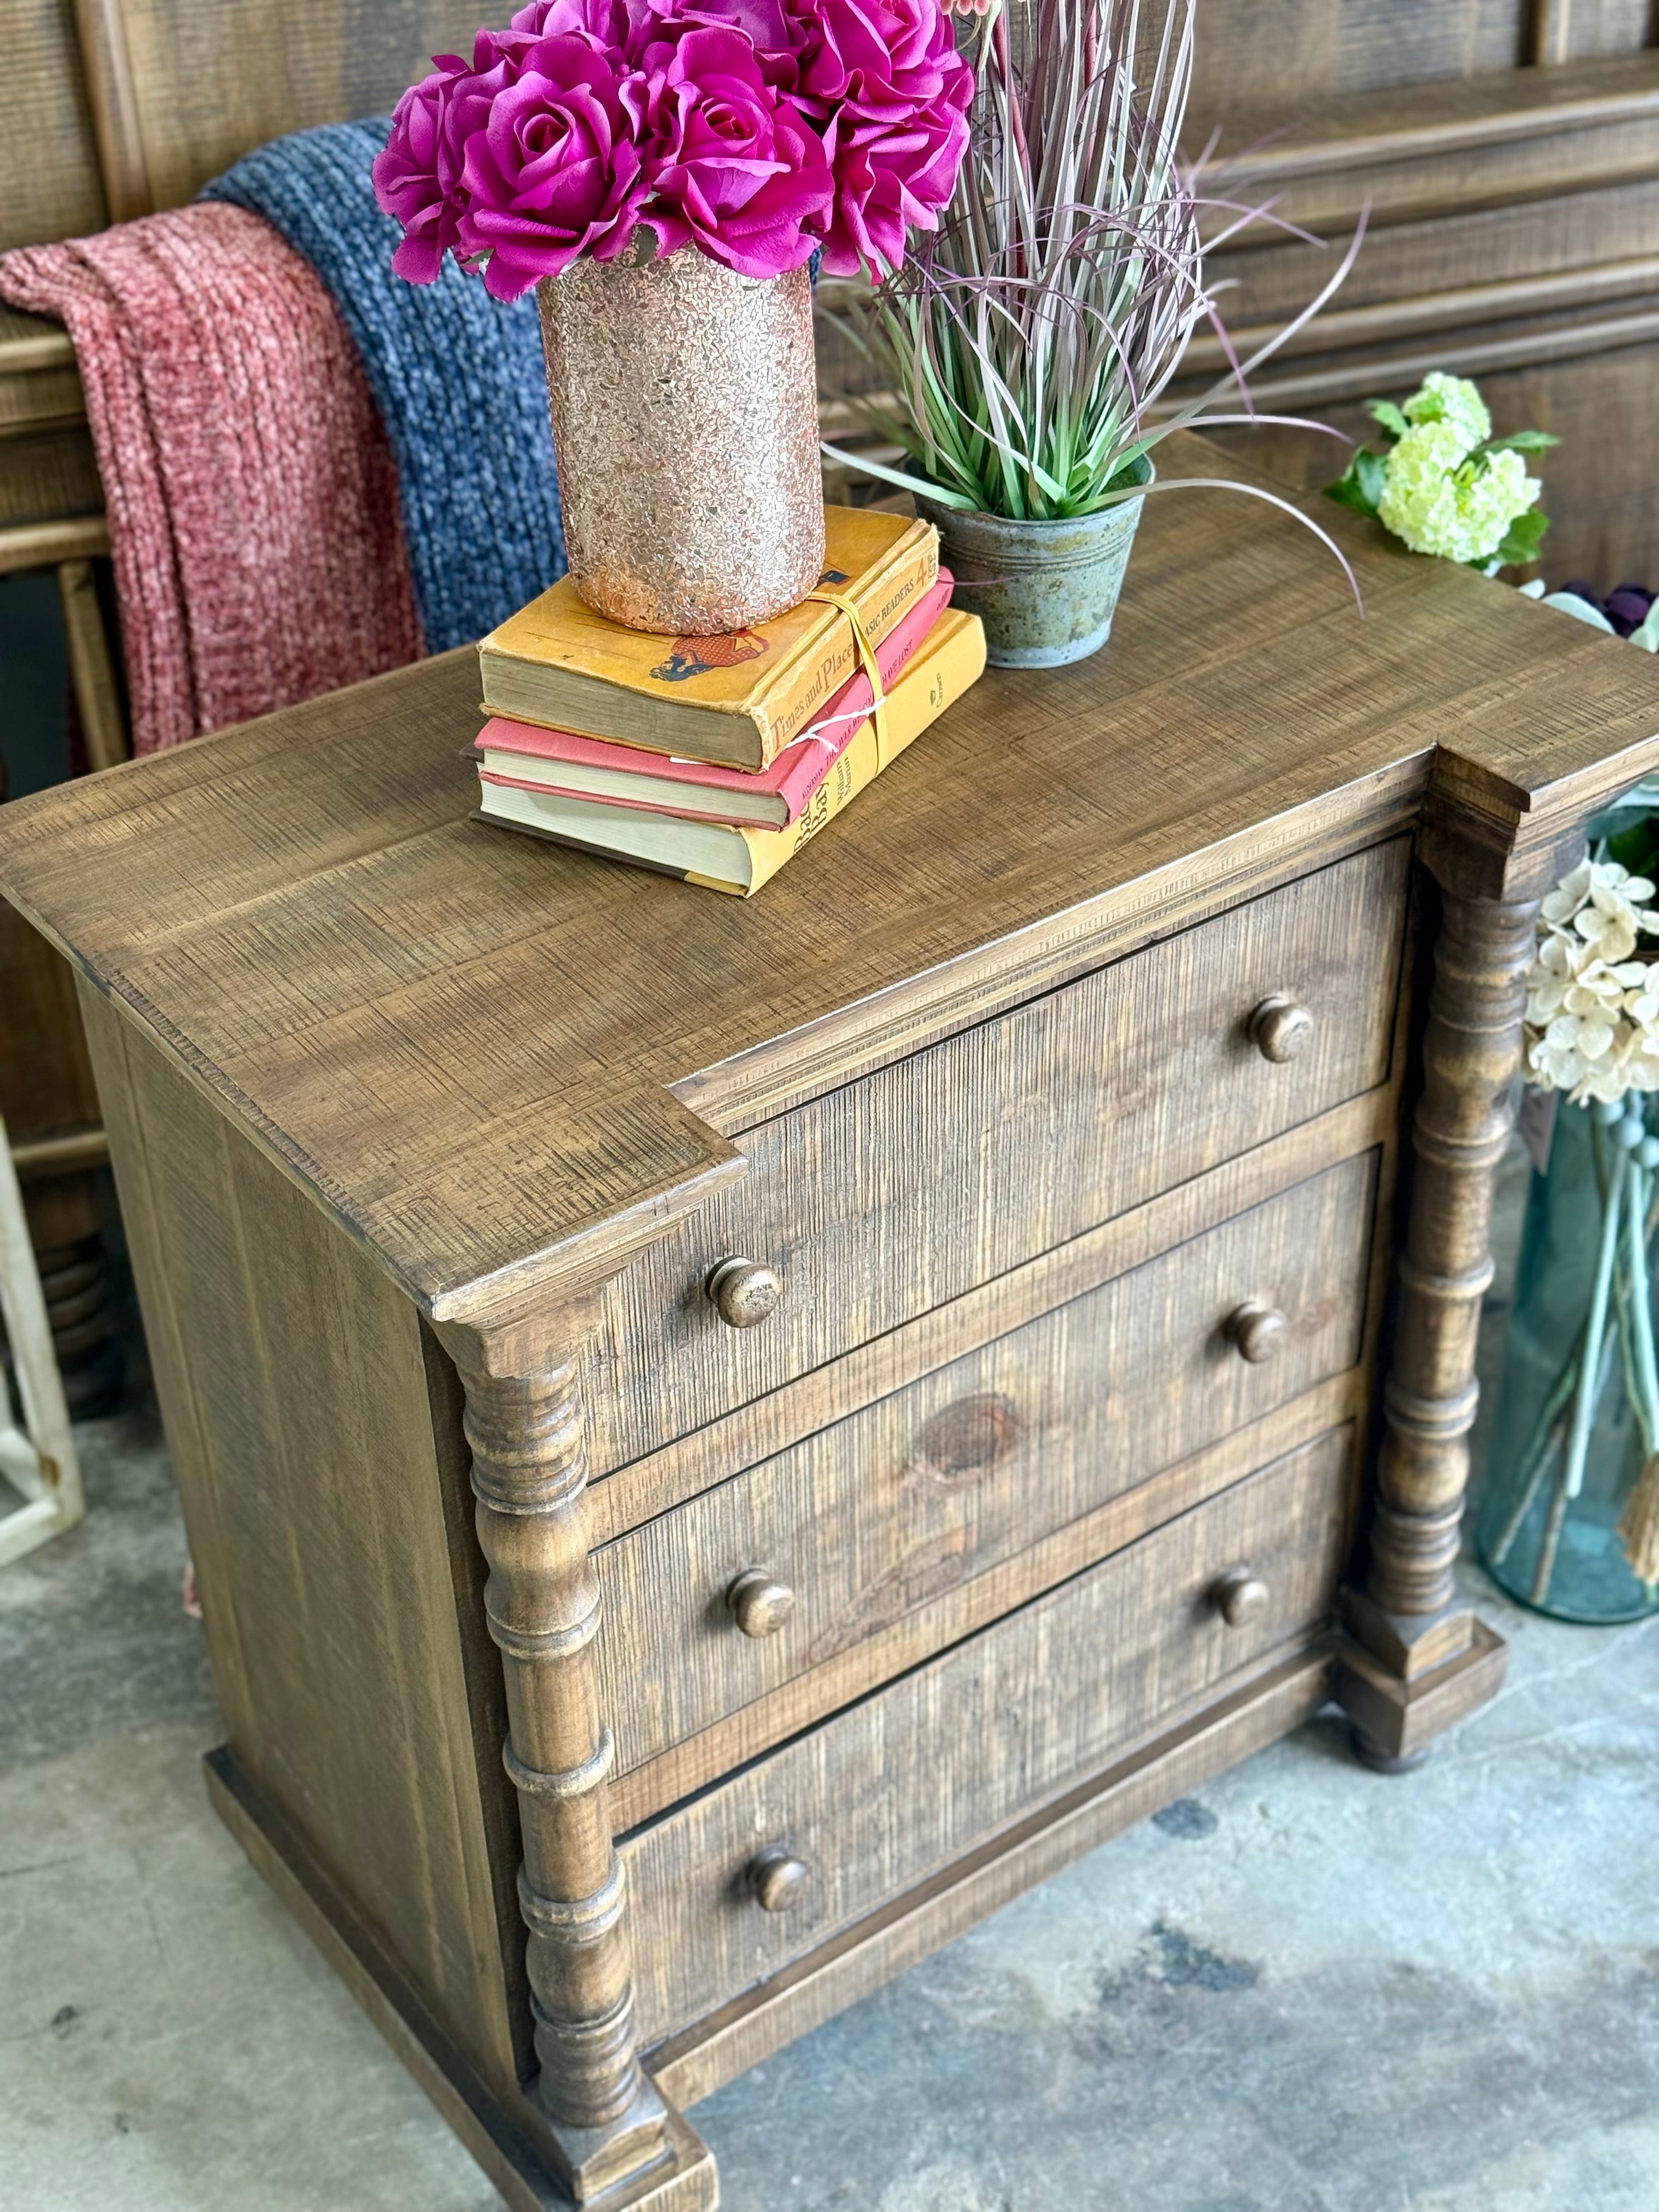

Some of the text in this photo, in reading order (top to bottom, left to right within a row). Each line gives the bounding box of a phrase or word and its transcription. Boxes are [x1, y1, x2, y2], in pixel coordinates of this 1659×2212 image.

[865, 557, 927, 638] ASIC READERS 4
[882, 659, 897, 686] HAVE
[899, 639, 912, 665] LOST
[770, 643, 854, 753] Times and Place
[794, 801, 811, 853] Bac
[811, 782, 829, 833] Bay
